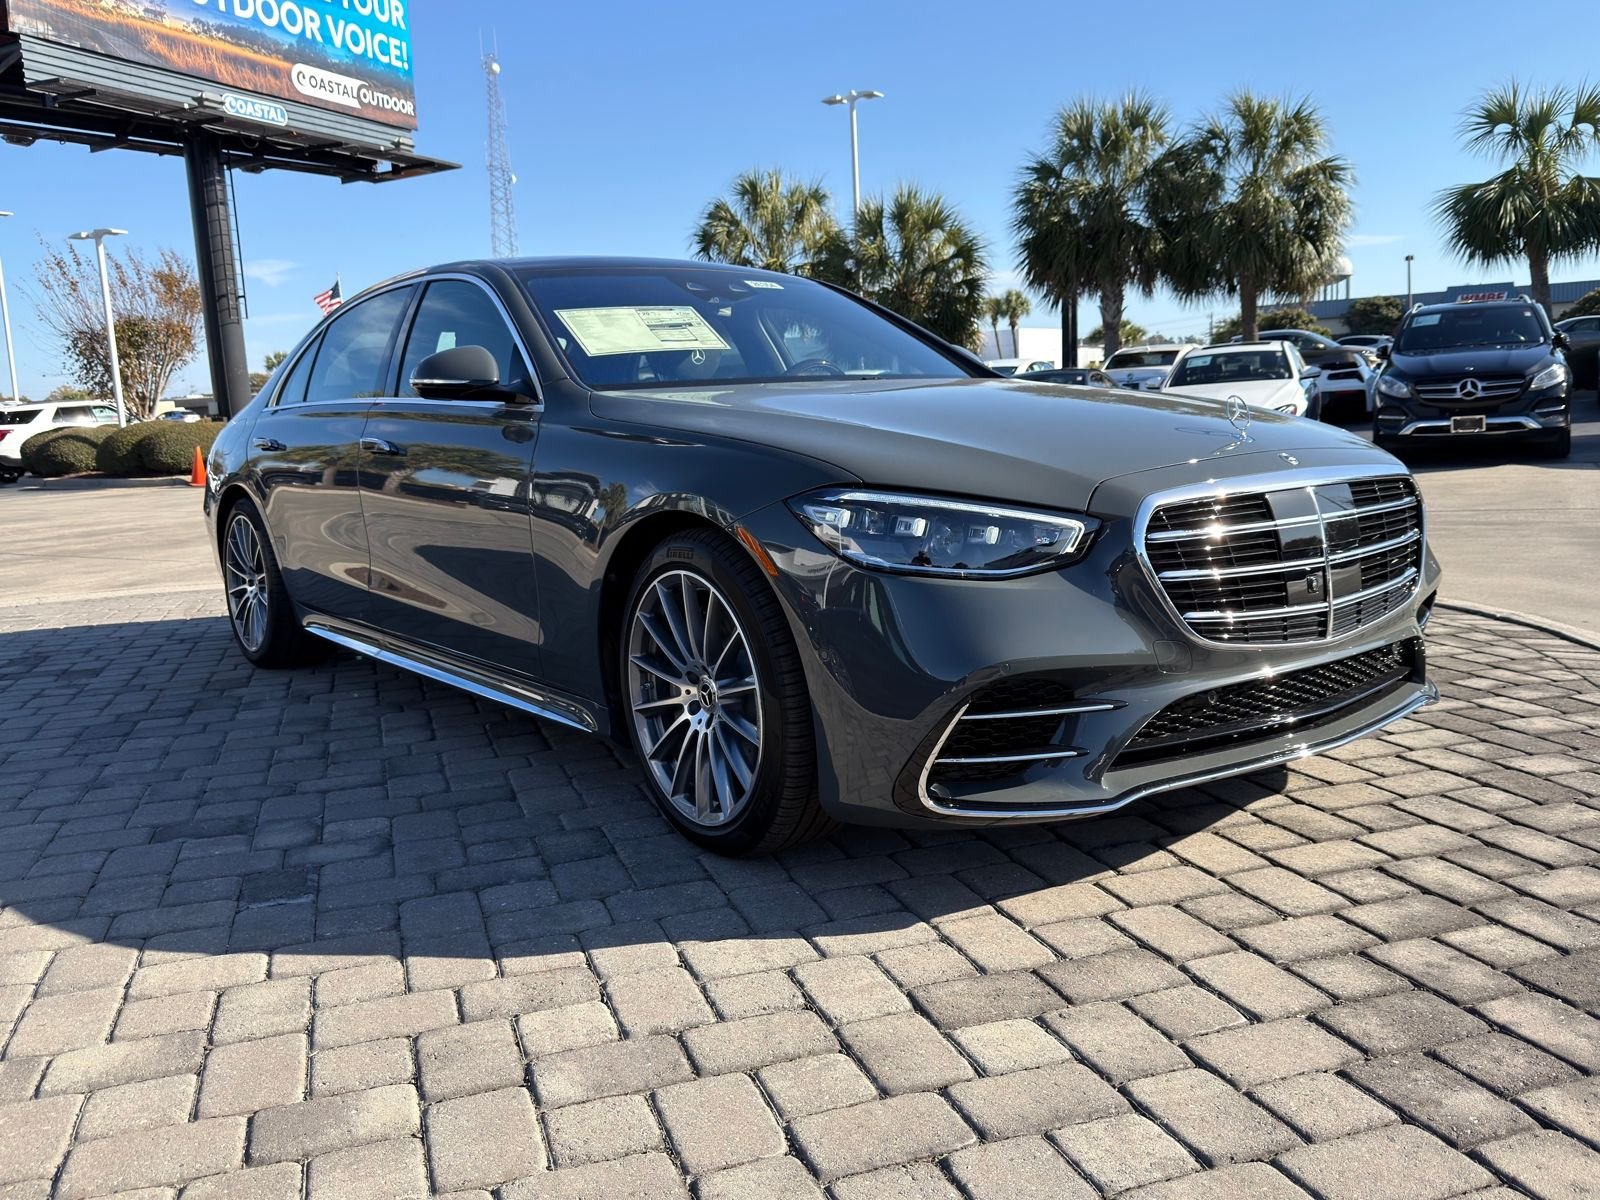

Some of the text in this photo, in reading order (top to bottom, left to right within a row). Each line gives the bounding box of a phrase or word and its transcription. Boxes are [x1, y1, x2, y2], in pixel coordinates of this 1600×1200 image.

[326, 14, 409, 70] VOICE!
[225, 96, 285, 122] COASTAL
[296, 70, 415, 116] COASTAL OUTDOOR
